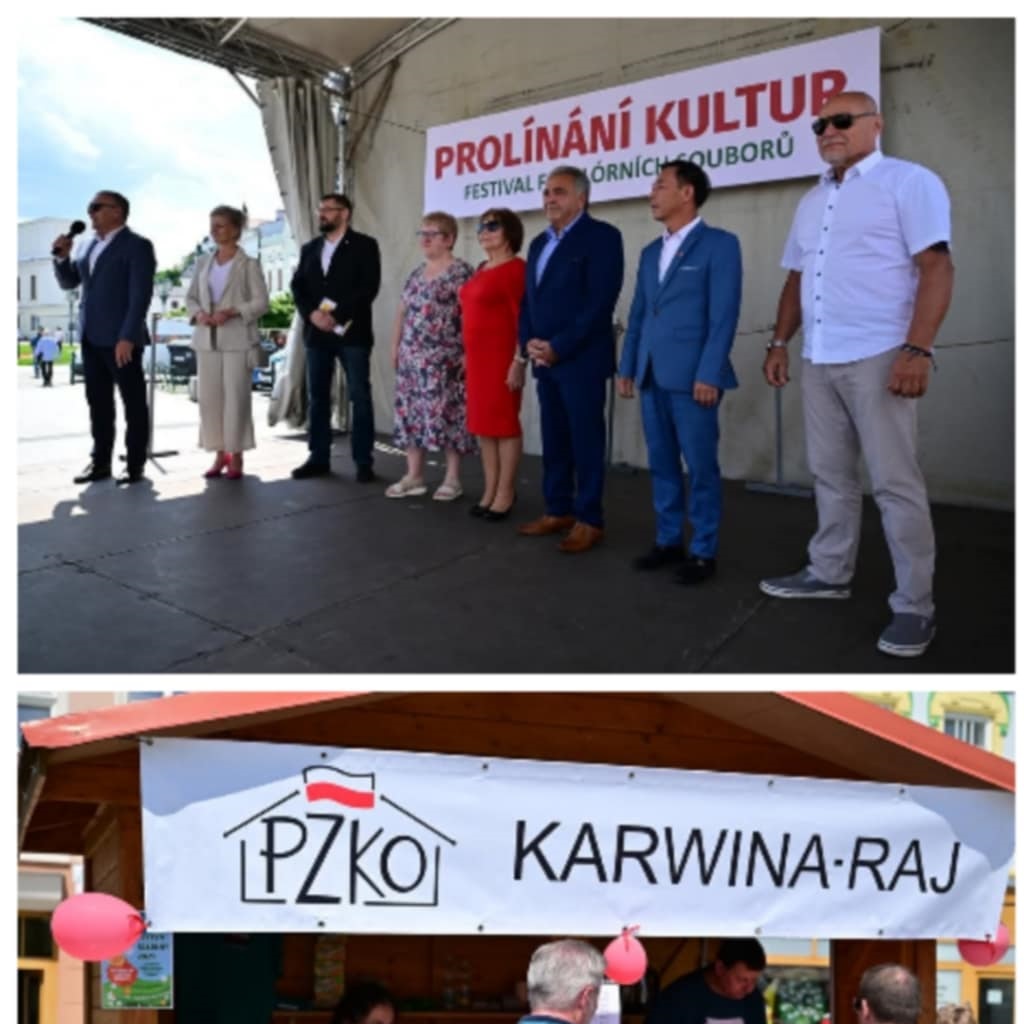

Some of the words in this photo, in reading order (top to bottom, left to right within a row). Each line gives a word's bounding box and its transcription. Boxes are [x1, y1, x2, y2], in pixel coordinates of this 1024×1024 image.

[434, 96, 633, 179] PROLÍNÁNÍ
[645, 69, 848, 145] KULTUR
[464, 174, 534, 200] FESTIVAL
[260, 813, 428, 905] PZKO
